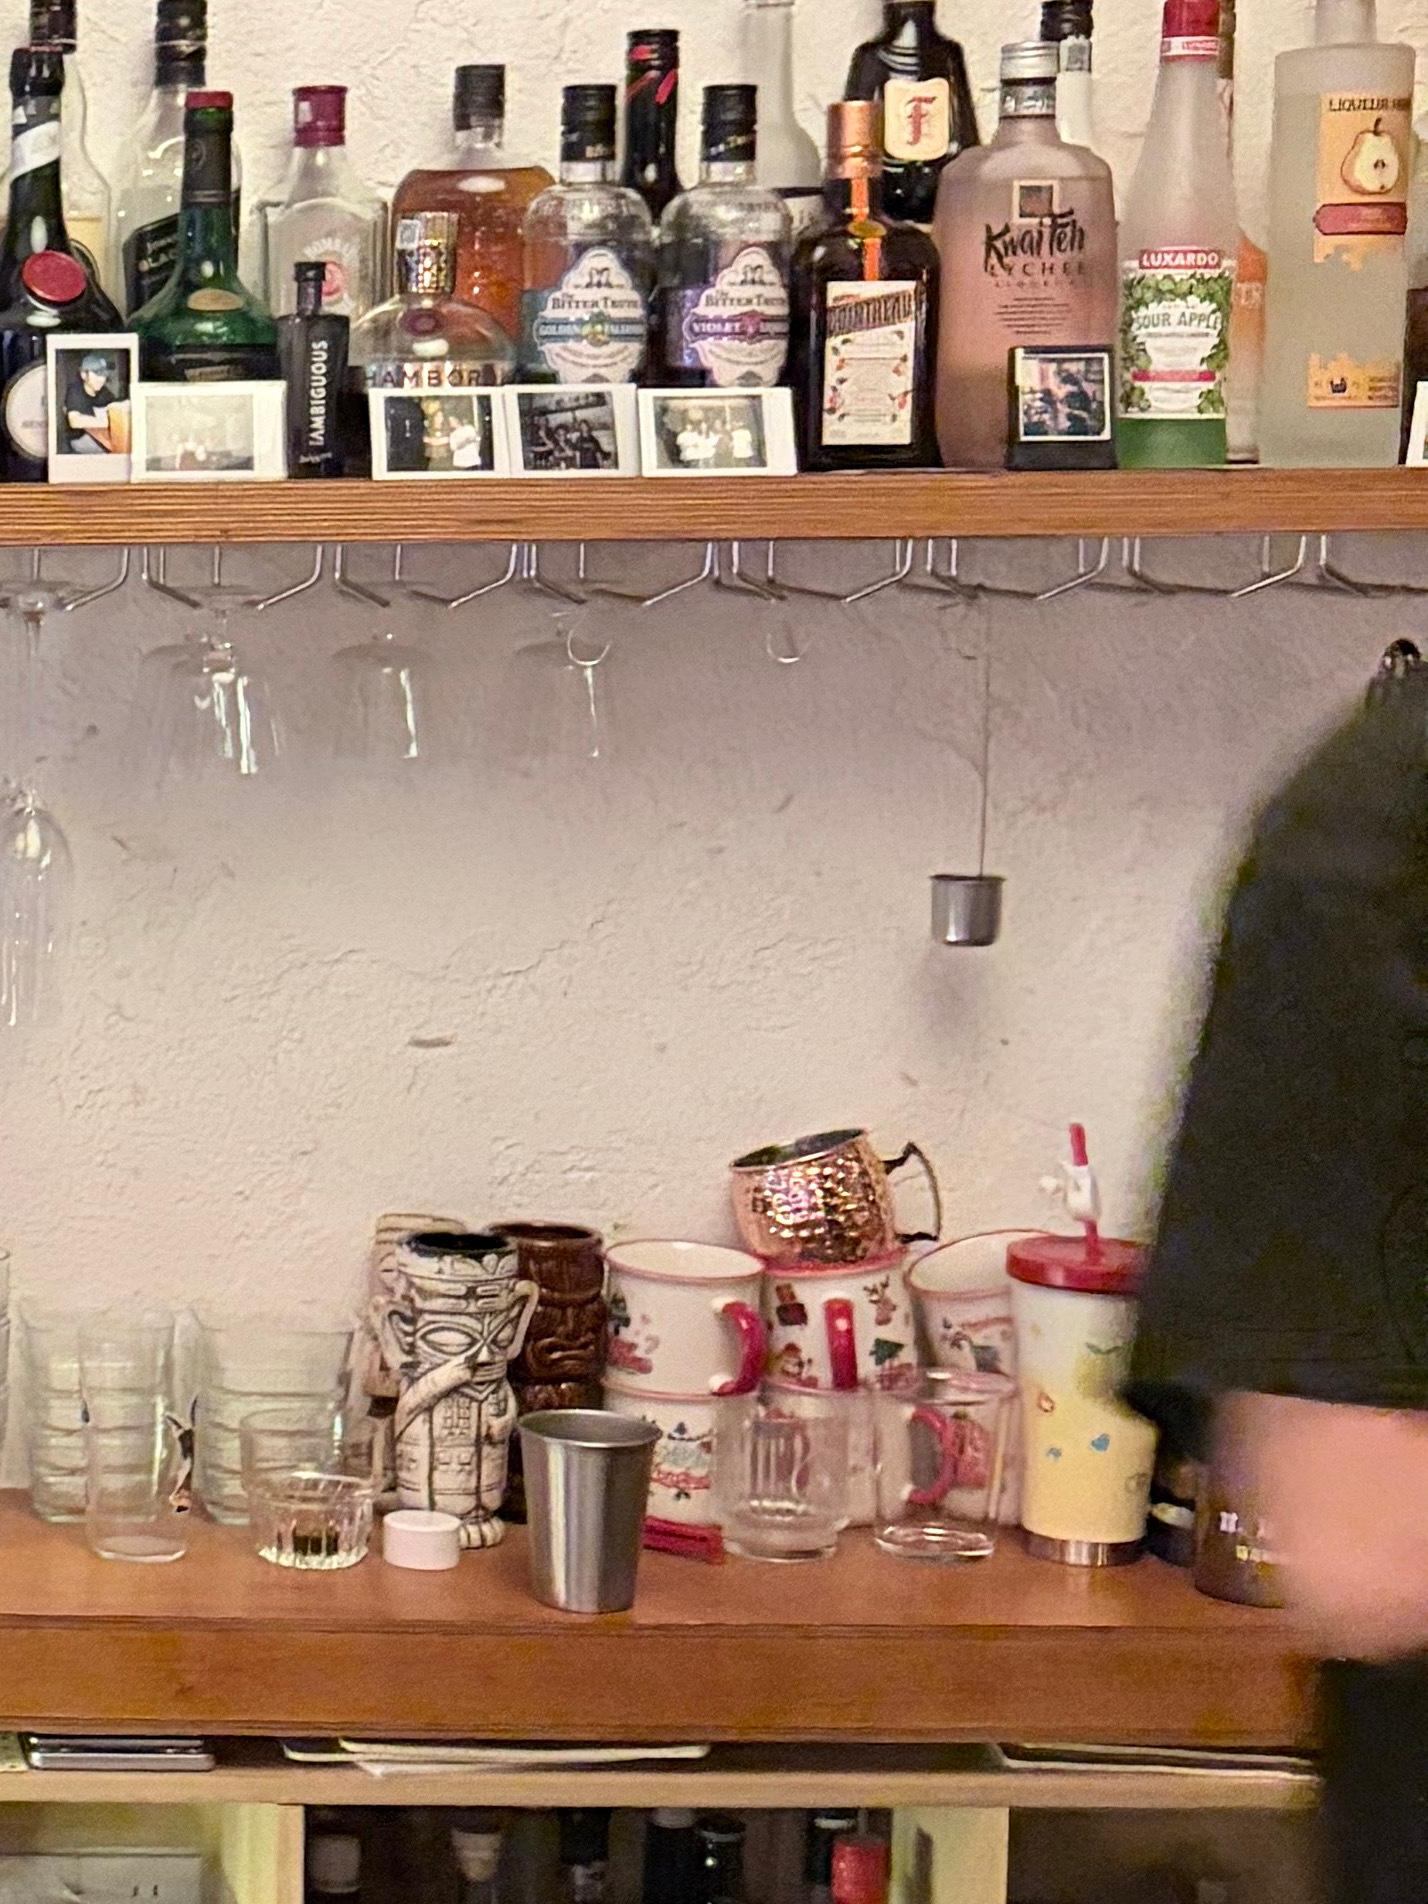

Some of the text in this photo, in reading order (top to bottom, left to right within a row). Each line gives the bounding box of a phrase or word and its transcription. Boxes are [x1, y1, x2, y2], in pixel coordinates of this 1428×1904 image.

[1142, 251, 1220, 267] LUXARDO
[1135, 310, 1222, 331] SOUR APPLE
